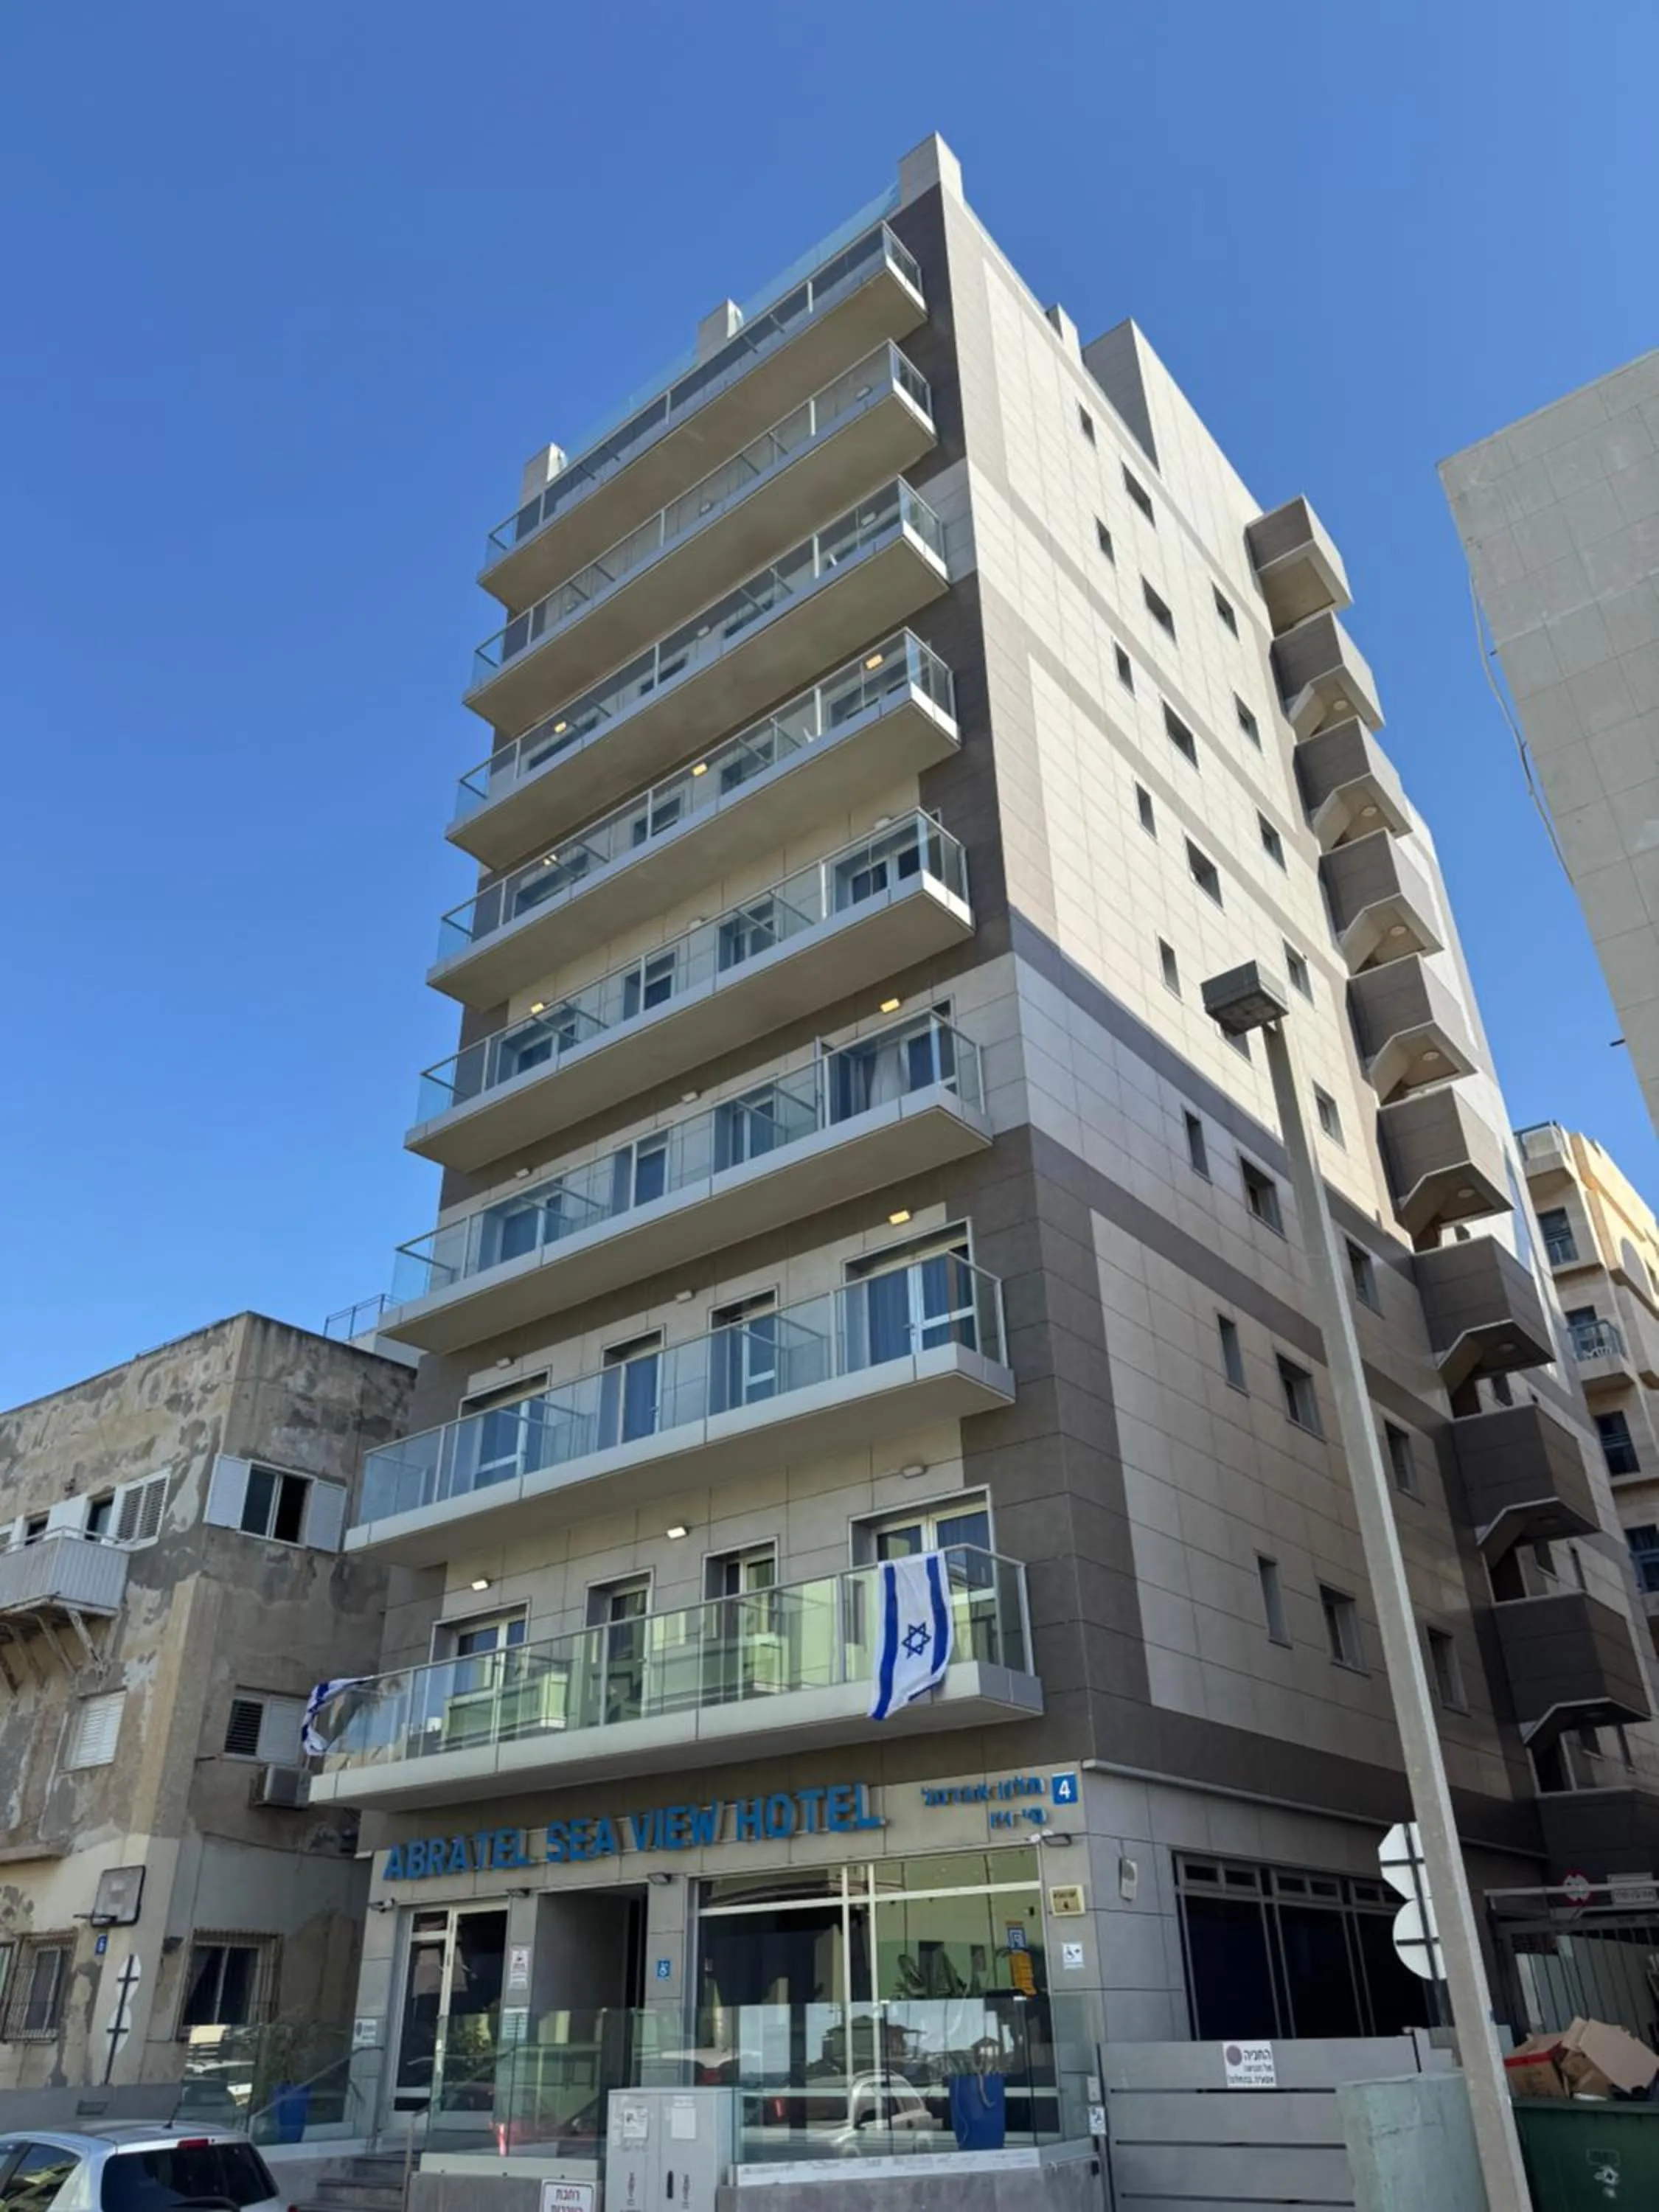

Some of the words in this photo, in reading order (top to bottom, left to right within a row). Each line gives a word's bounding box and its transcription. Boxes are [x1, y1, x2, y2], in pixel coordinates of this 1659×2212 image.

[1058, 1778, 1071, 1800] 4
[383, 1827, 531, 1882] ABRATEL
[546, 1815, 616, 1864] SEA
[629, 1795, 719, 1853] VIEW
[736, 1782, 882, 1842] HOTEL
